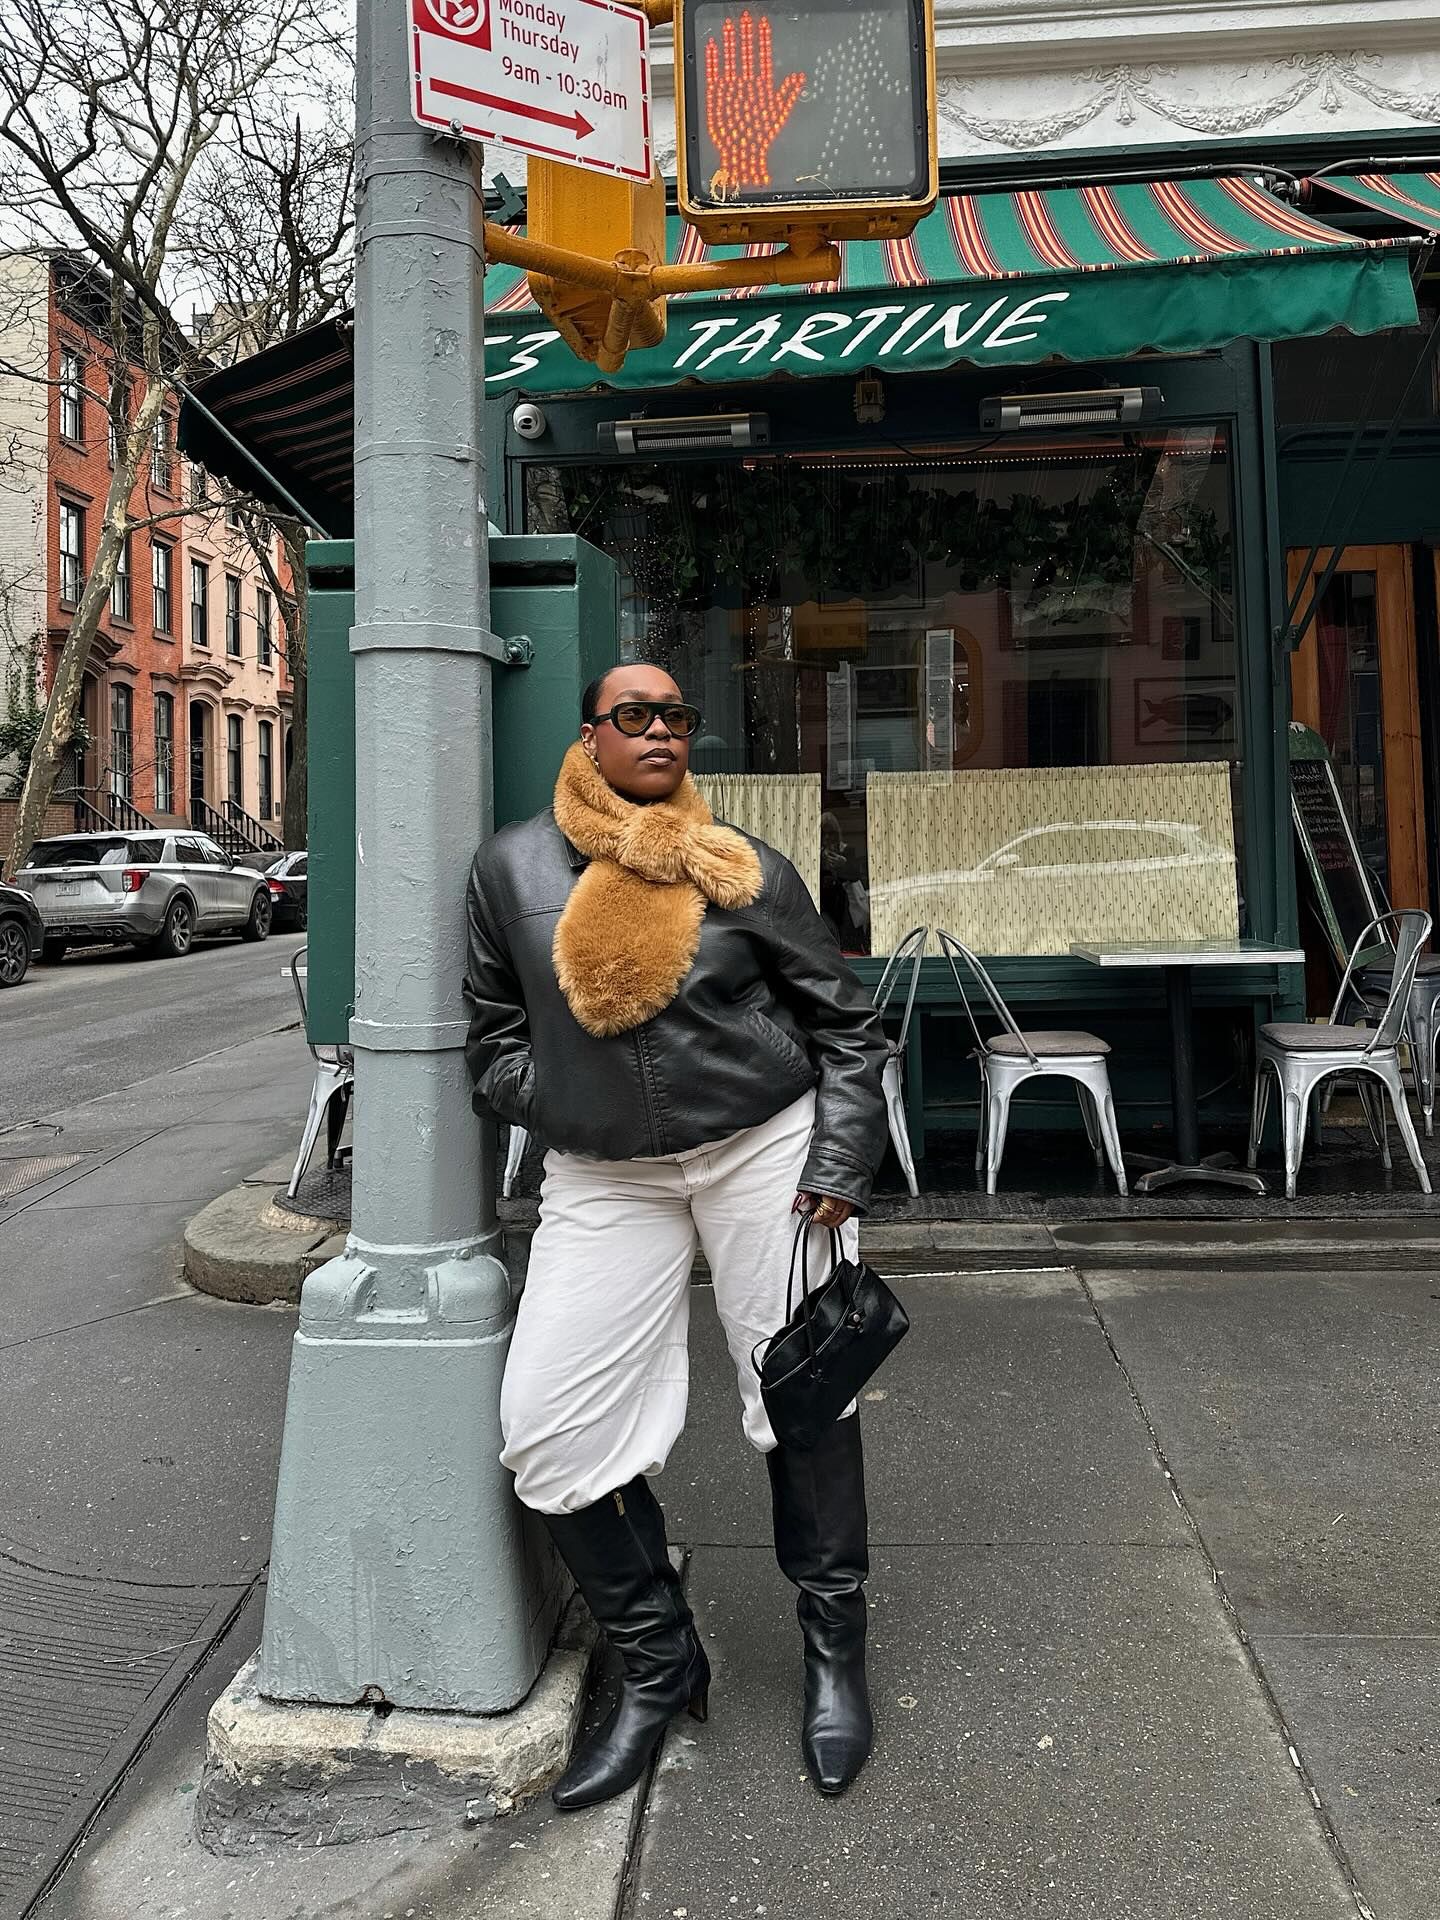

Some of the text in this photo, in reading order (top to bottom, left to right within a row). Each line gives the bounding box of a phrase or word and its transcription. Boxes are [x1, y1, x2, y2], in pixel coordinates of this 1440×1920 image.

[499, 0, 566, 33] Monday
[500, 17, 579, 64] Thursday
[502, 56, 539, 85] 9am
[557, 72, 627, 110] 10:30am
[674, 291, 1070, 371] TARTINE
